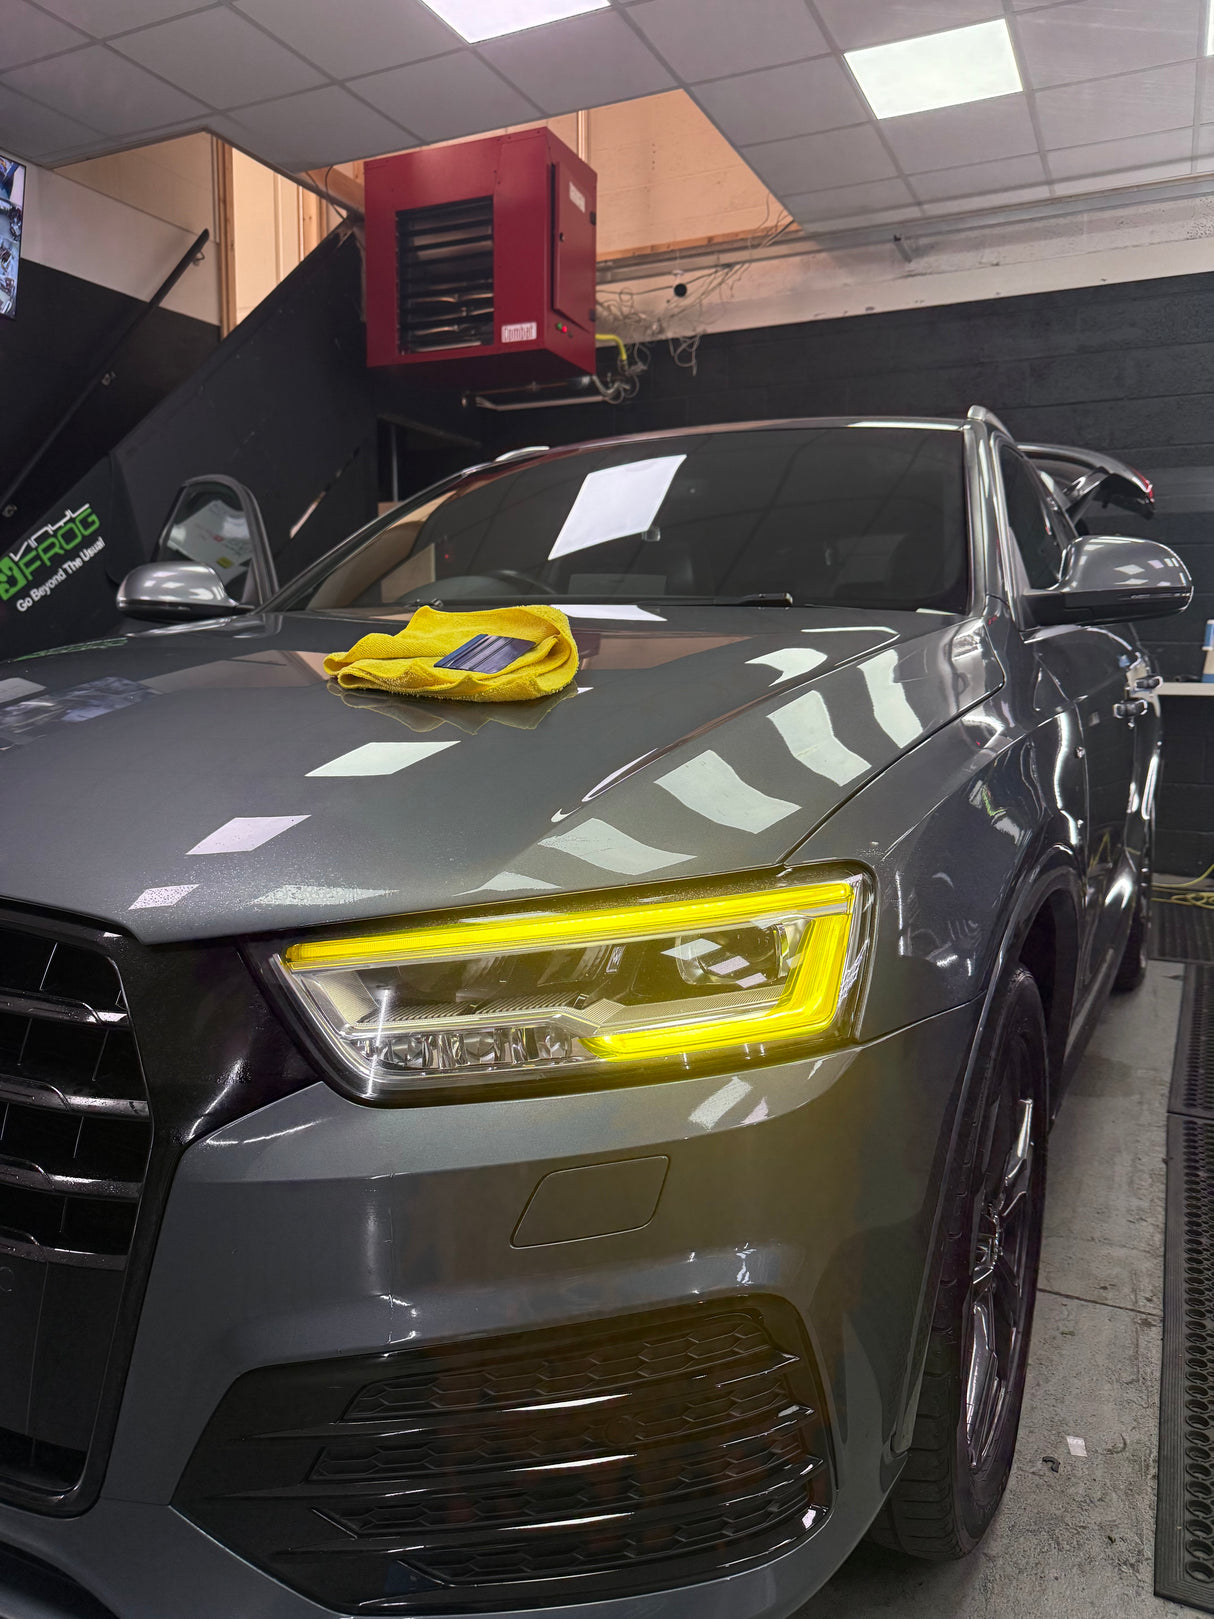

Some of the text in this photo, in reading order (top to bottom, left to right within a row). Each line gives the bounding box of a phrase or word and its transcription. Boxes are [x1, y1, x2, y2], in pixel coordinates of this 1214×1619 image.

[18, 507, 100, 581] FROG
[16, 597, 33, 612] Go
[30, 568, 67, 602] Beyond
[62, 557, 84, 575] The
